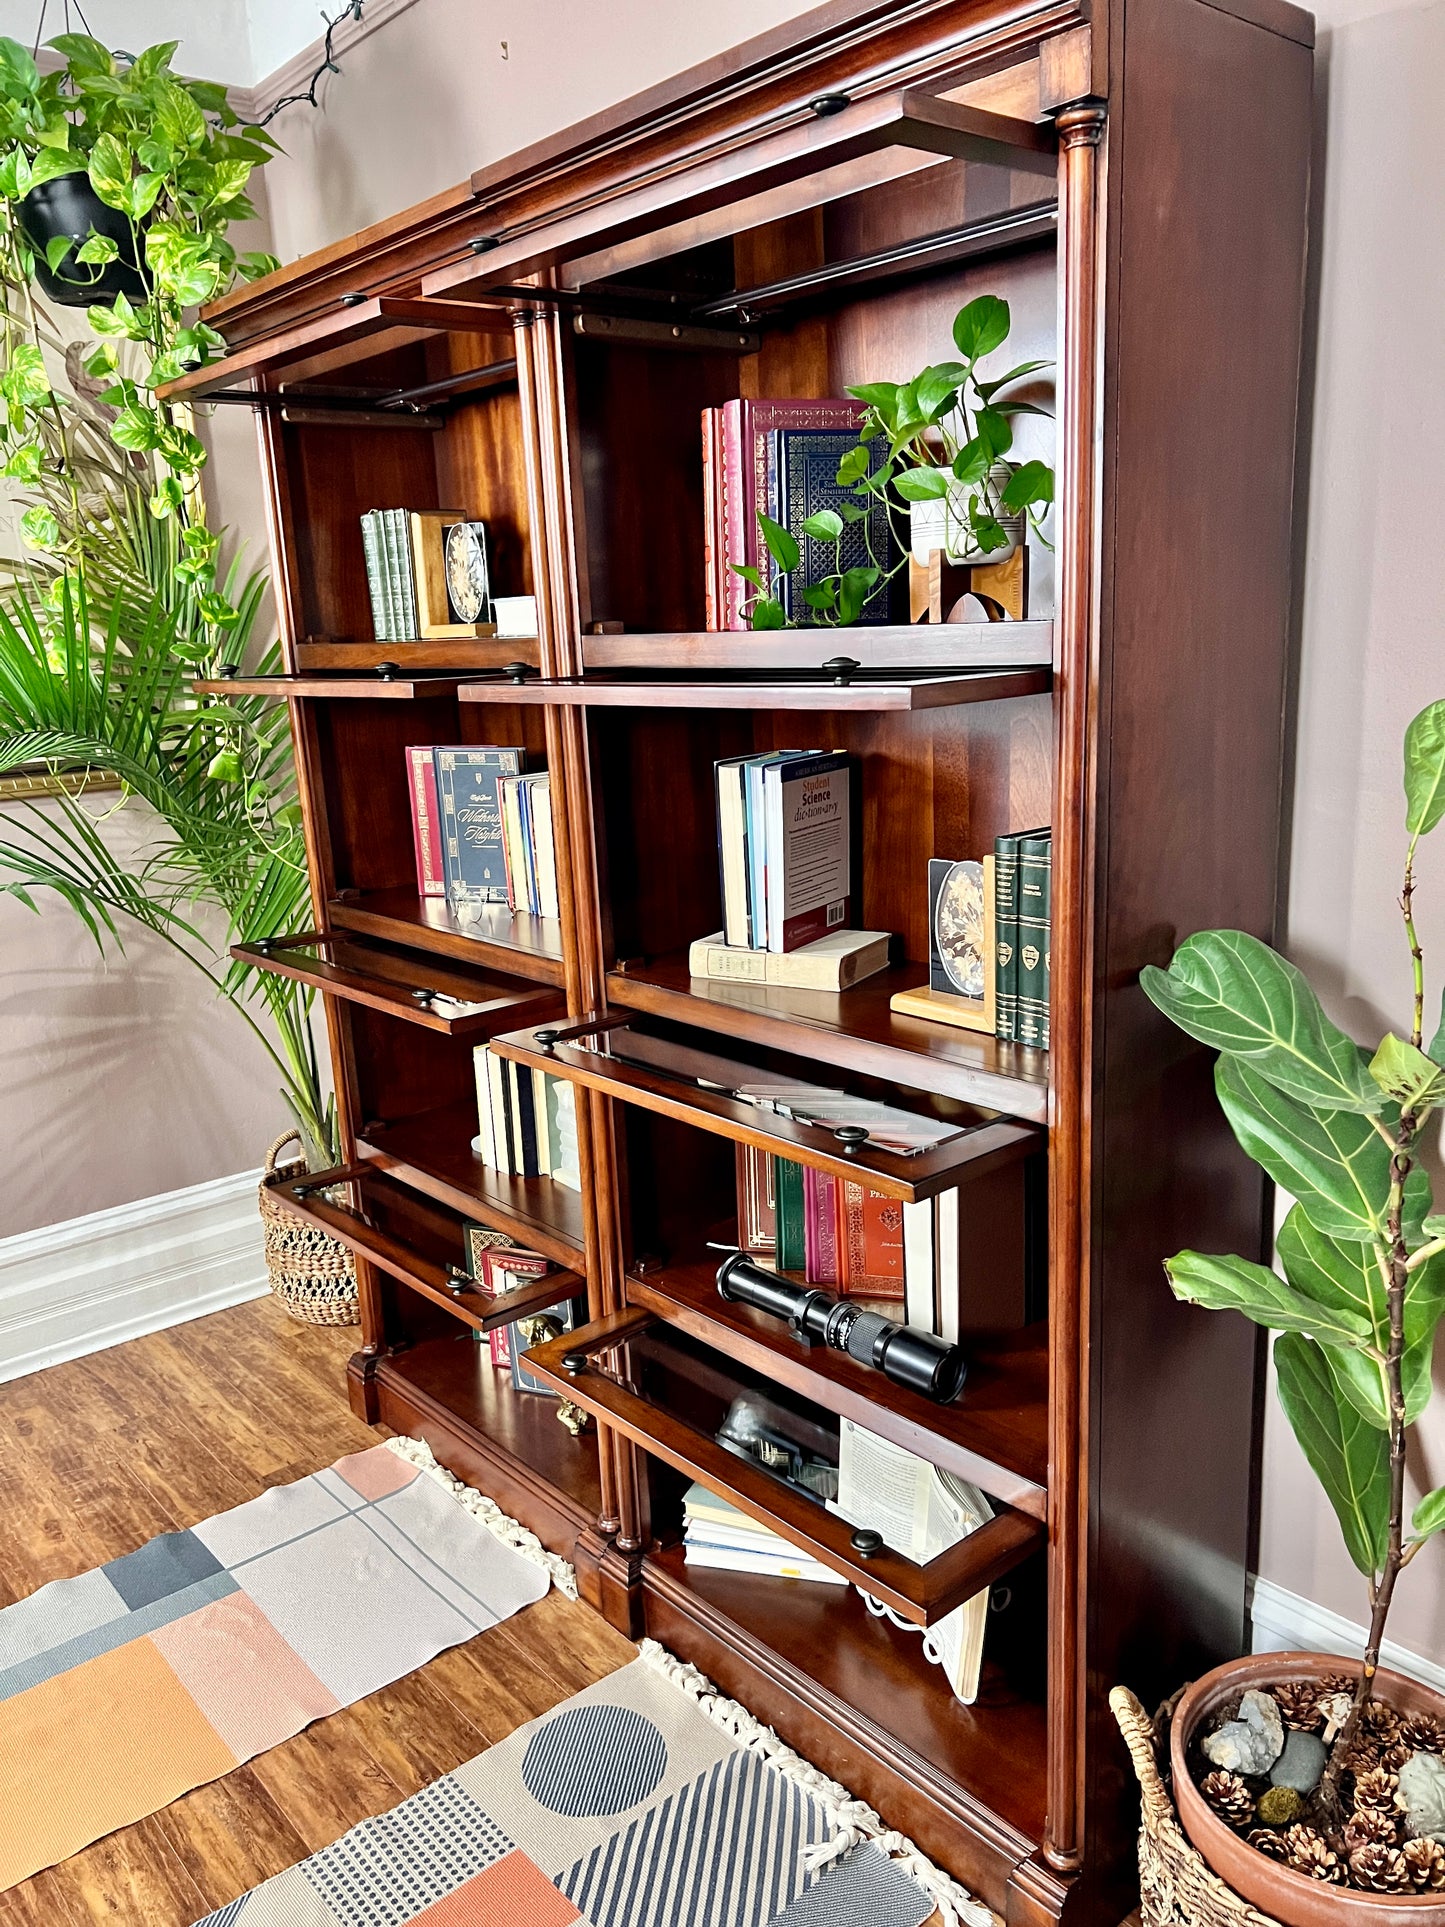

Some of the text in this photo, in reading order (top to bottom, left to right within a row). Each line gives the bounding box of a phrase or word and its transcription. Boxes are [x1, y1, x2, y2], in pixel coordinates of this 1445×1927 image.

[820, 487, 854, 495] SENSIBILIT
[802, 776, 830, 792] Student
[802, 790, 831, 806] Science
